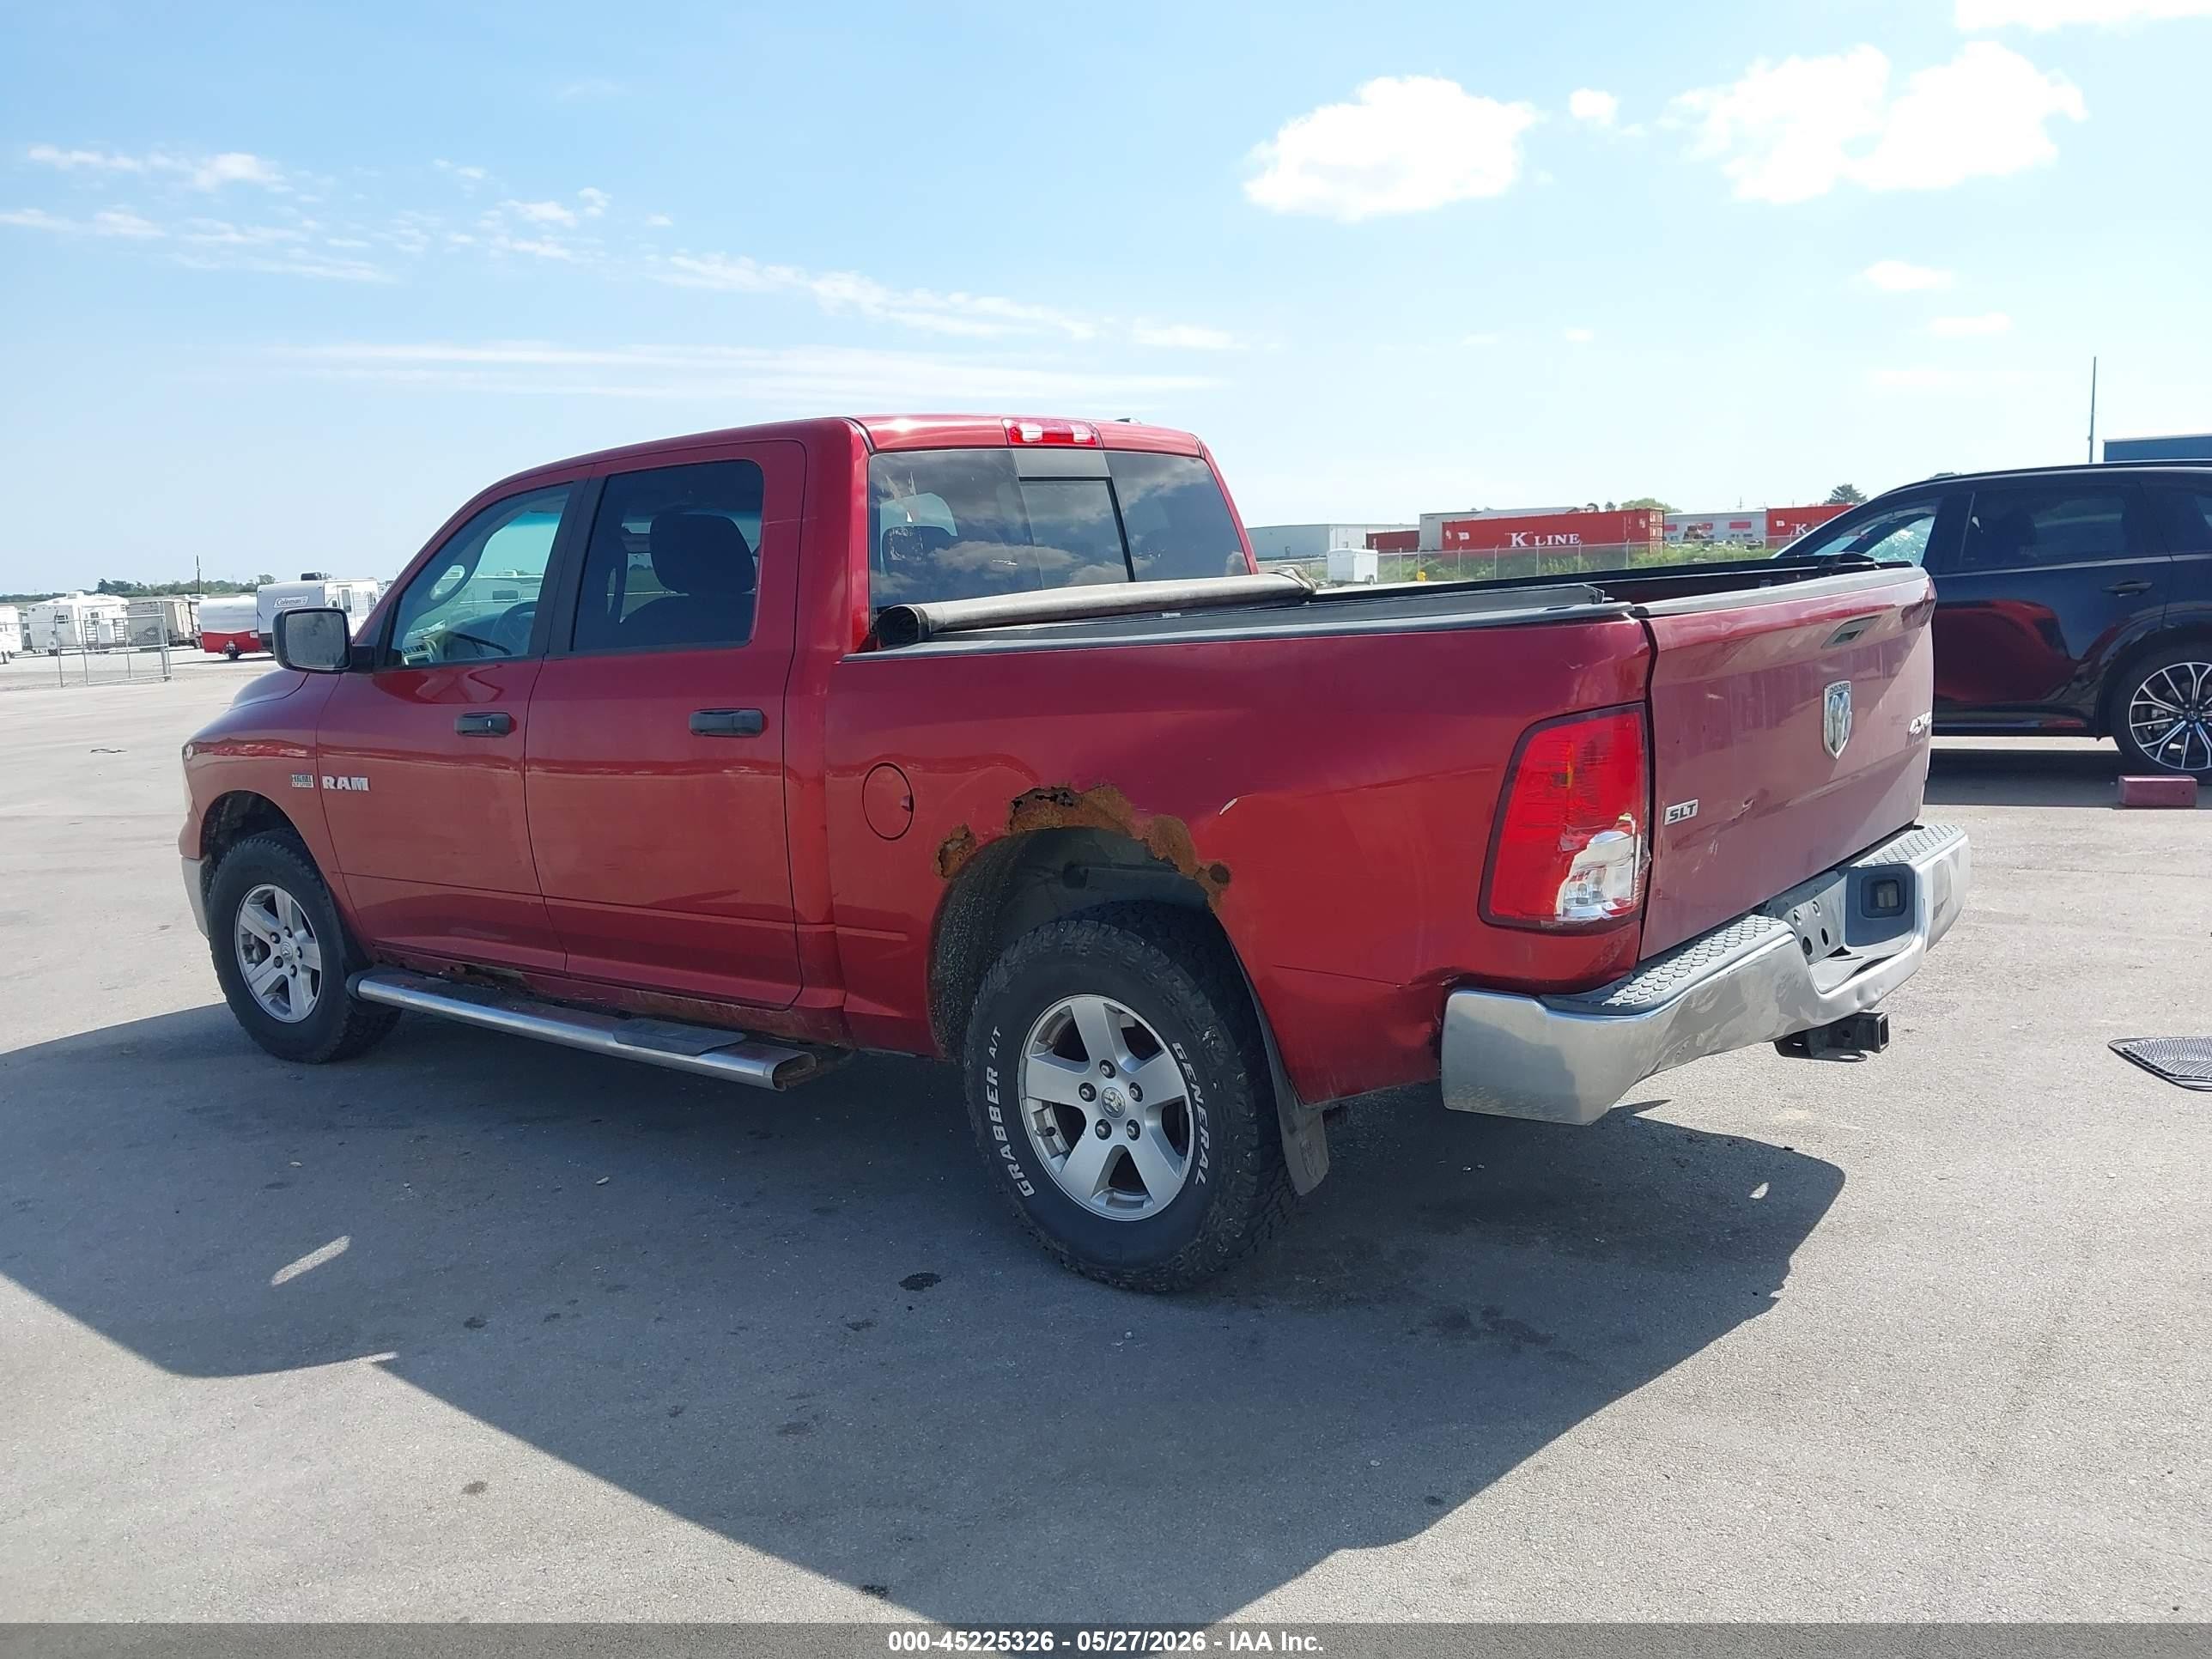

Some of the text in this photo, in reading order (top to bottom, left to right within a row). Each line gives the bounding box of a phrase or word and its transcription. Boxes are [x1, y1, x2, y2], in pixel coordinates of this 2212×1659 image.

[1534, 533, 1581, 546] LINE
[1829, 683, 1850, 695] DODGE
[322, 775, 369, 791] RAM
[1668, 803, 1697, 822] SLT
[987, 1026, 1036, 1197] GRABBER A/T
[1172, 1042, 1210, 1185] GENERAL
